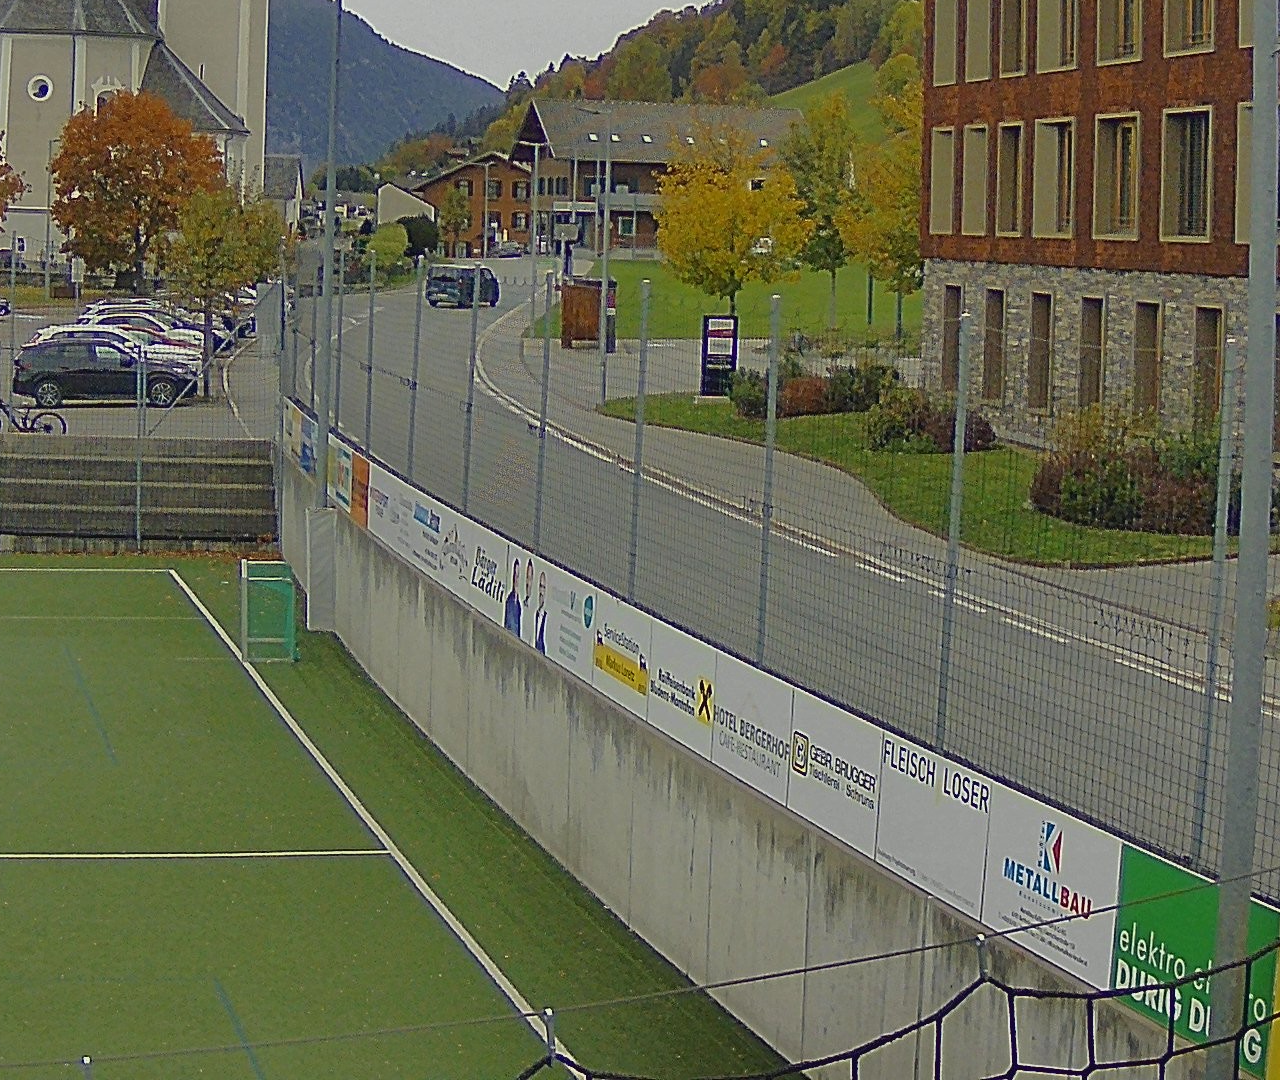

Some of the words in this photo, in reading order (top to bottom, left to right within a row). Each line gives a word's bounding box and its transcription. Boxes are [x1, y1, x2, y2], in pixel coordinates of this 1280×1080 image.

[714, 704, 738, 734] HOTEL
[740, 719, 791, 761] BERGERHOF
[810, 744, 834, 771] GEBR.
[835, 757, 877, 794] BRUGGER
[846, 784, 875, 810] Schruns
[883, 739, 937, 788] FLEISCH
[943, 767, 989, 814] LOSER
[1003, 857, 1093, 920] METALLBAU
[1119, 922, 1186, 980] elektro
